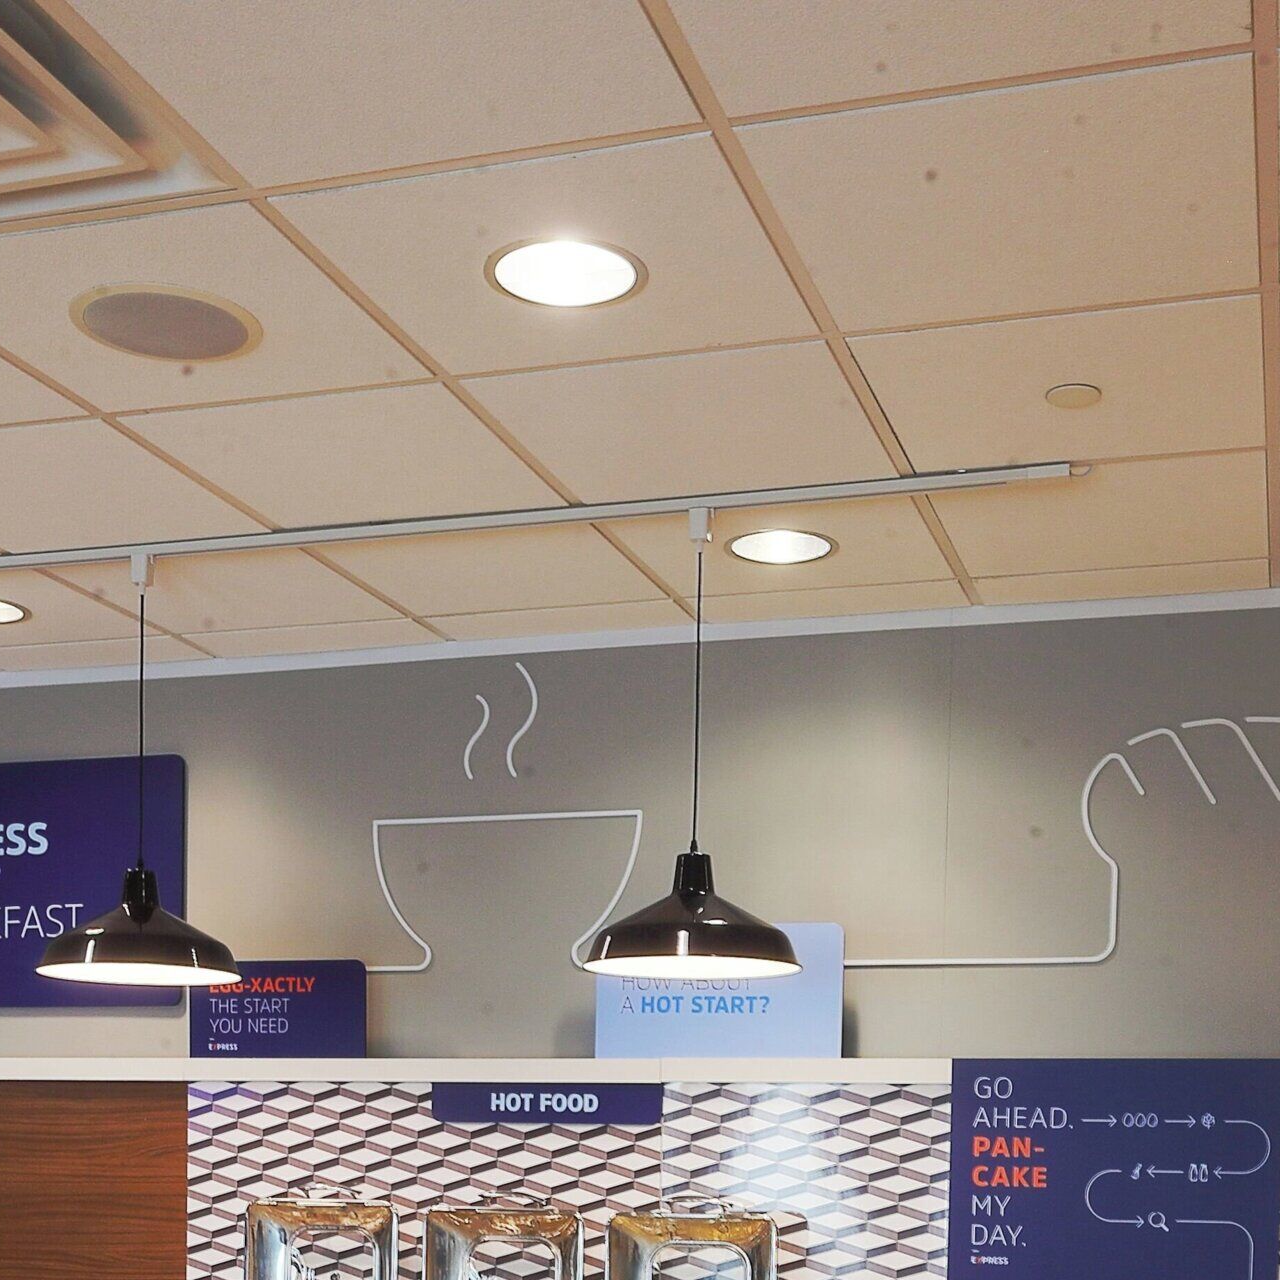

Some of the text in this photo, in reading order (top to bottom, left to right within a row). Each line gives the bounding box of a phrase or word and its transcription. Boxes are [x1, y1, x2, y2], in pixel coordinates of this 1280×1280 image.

[209, 998, 291, 1014] THE START
[621, 996, 770, 1014] A HOT START?
[209, 1018, 289, 1034] YOU NEED
[973, 1076, 1013, 1099] GO
[490, 1092, 599, 1113] HOT FOOD
[972, 1106, 1074, 1129] AHEAD.
[972, 1136, 1045, 1158] PAN-
[971, 1165, 1048, 1188] CAKE
[972, 1195, 1011, 1217] MY
[970, 1223, 1026, 1247] DAY.
[970, 1256, 1009, 1265] EXPRESS
